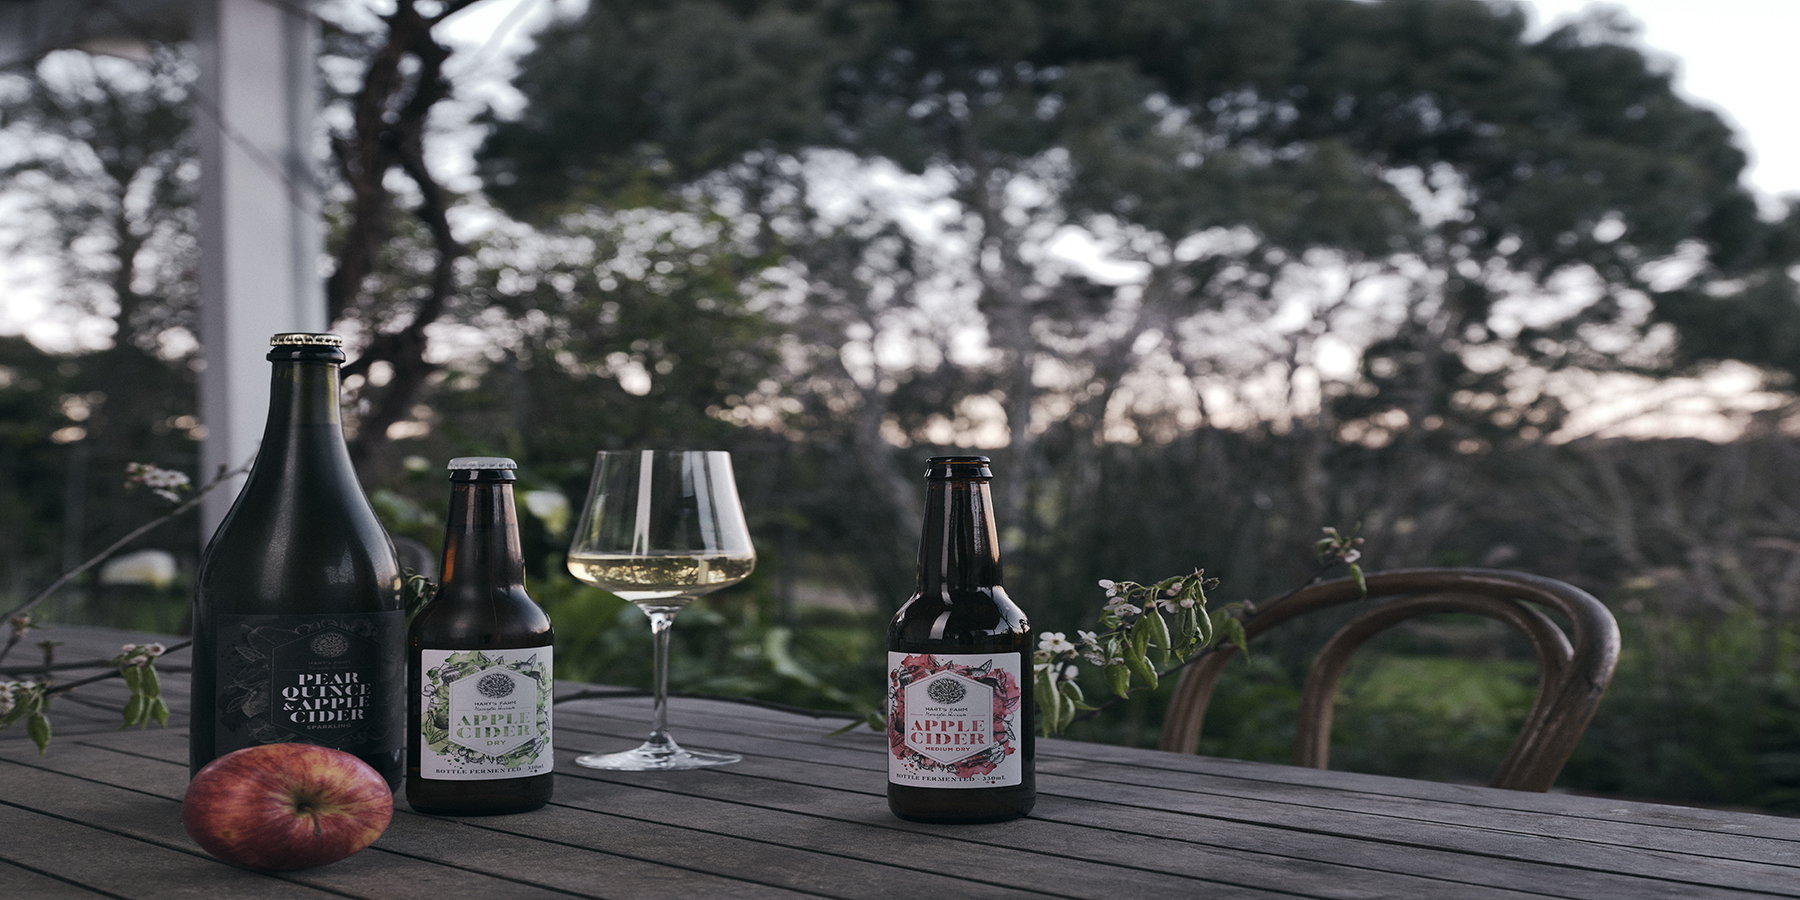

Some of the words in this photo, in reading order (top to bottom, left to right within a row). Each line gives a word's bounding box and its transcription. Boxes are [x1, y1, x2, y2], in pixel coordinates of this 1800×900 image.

[298, 672, 359, 685] PEAR
[281, 683, 371, 702] QUINCE
[290, 709, 364, 723] CIDER
[456, 711, 531, 726] APPLE
[456, 724, 531, 739] CIDER
[910, 719, 985, 732] APPLE
[910, 732, 986, 745] CIDER
[469, 767, 522, 775] FERMENTED
[896, 773, 920, 781] BOTTLE
